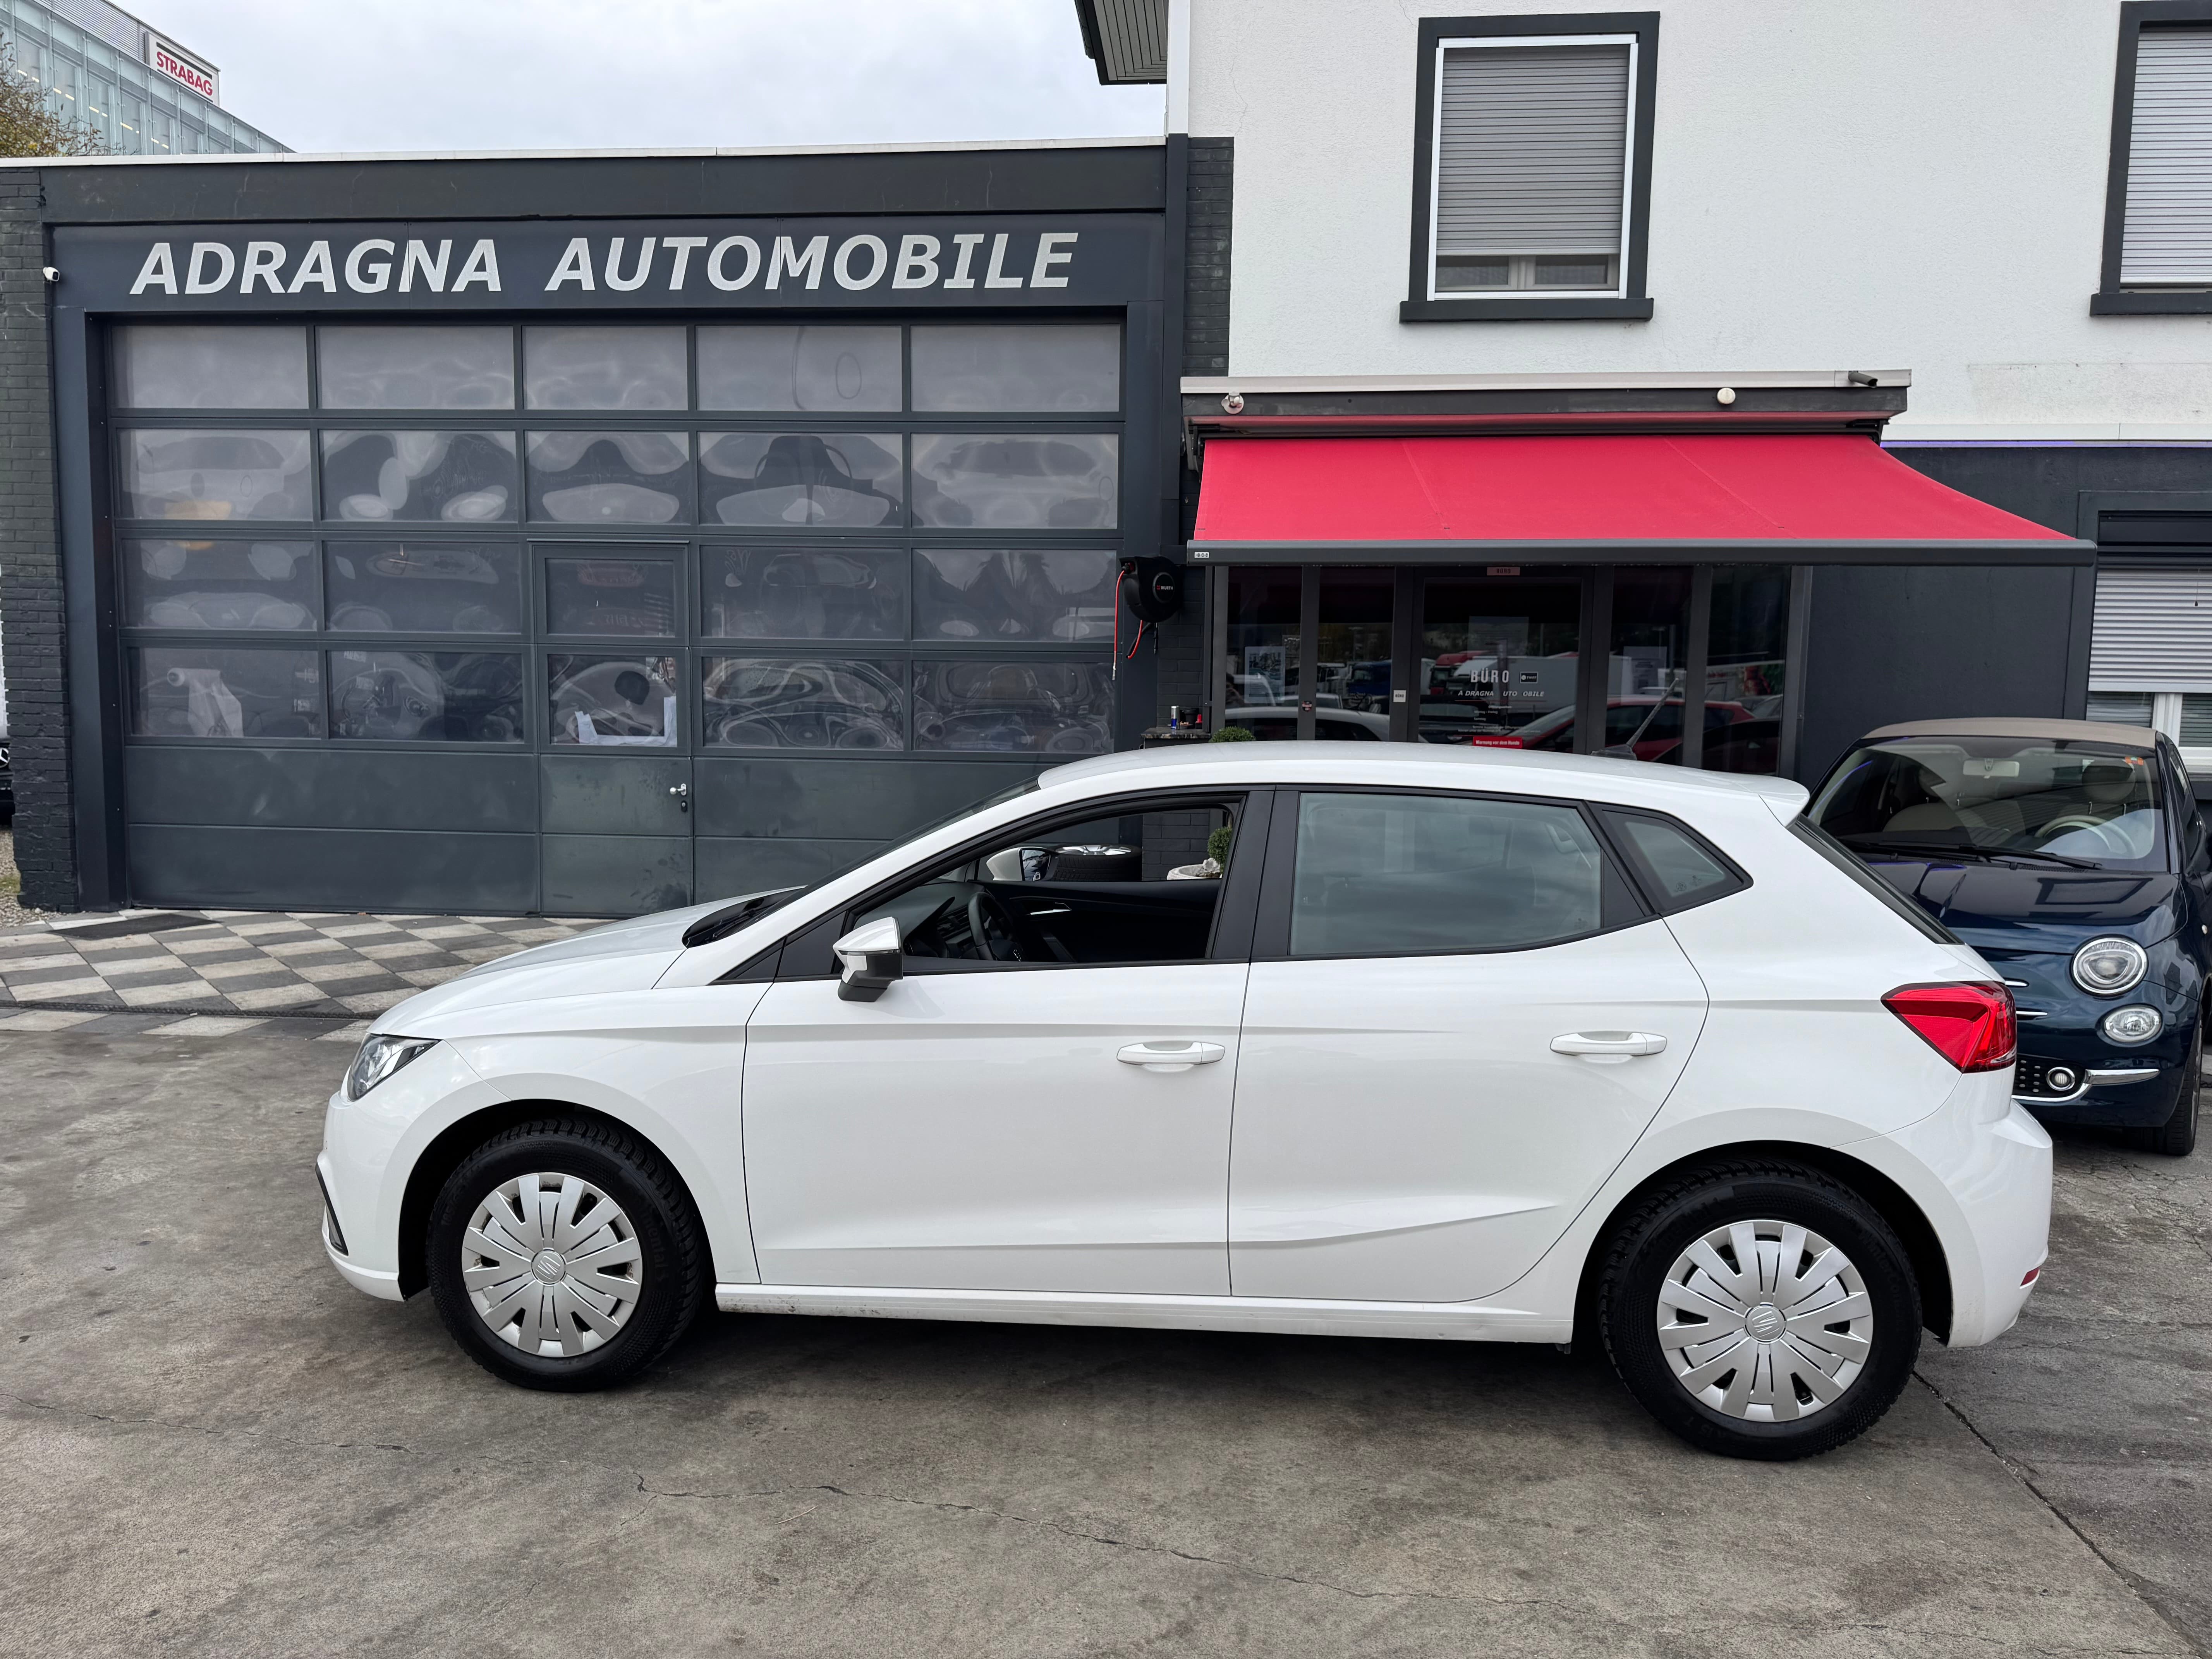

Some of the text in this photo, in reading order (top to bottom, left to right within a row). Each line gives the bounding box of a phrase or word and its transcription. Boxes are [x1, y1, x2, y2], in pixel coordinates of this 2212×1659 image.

[156, 51, 213, 96] STRABAG
[129, 233, 1078, 294] ADRAGNA AUTOMOBILE
[1470, 668, 1510, 683] BÜRO
